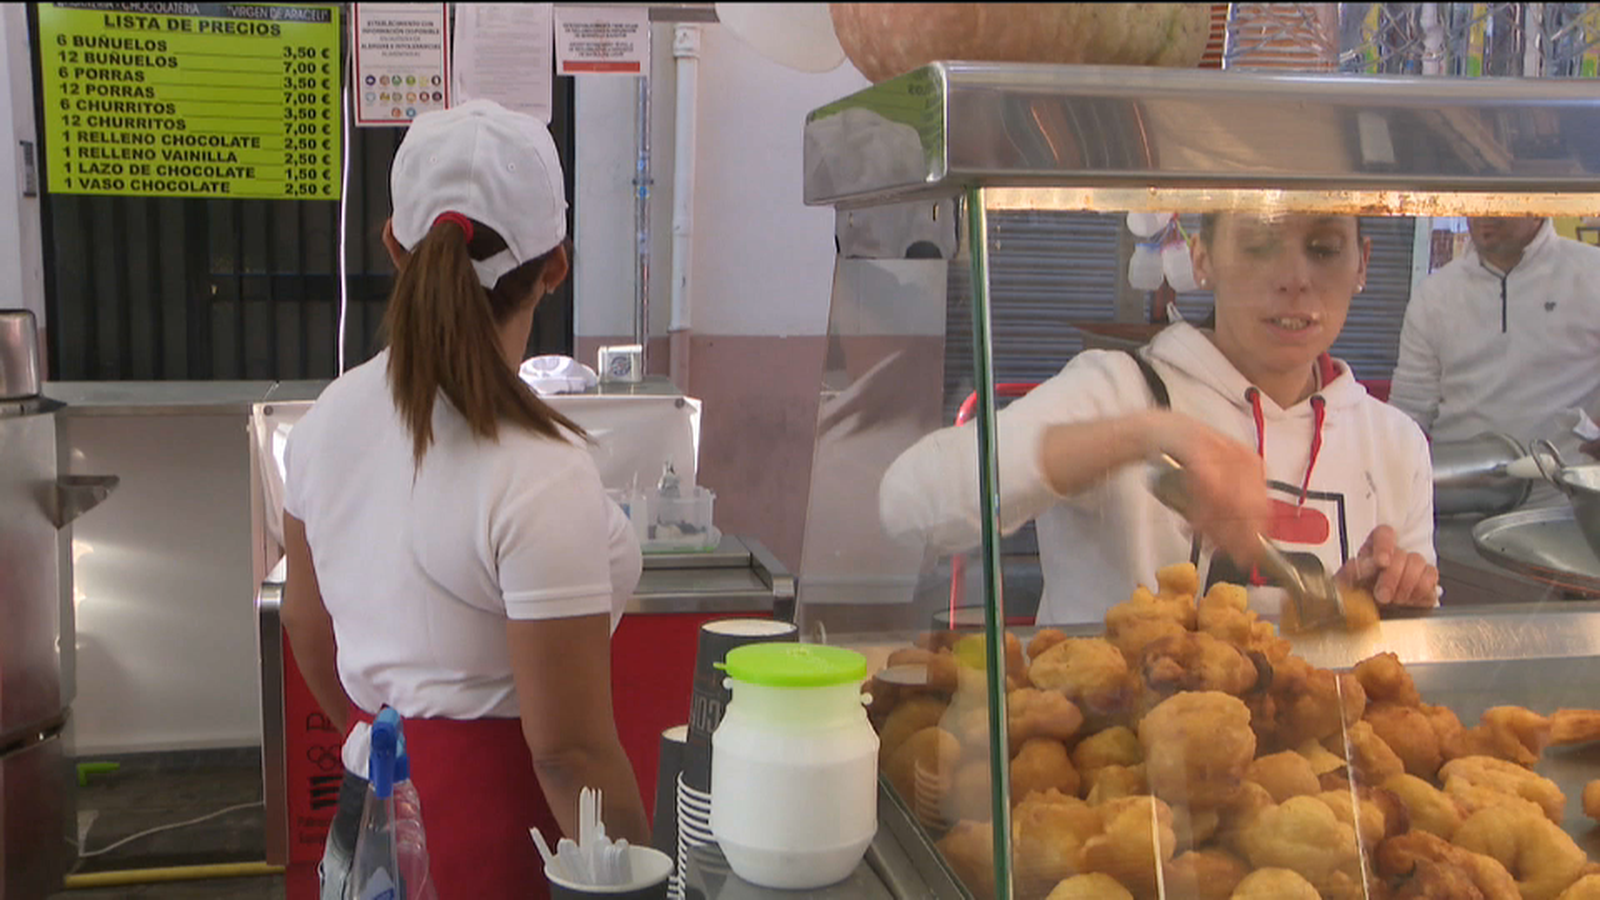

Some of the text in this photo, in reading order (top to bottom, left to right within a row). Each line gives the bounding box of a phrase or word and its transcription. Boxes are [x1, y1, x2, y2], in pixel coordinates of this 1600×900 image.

[270, 7, 283, 19] DE
[104, 14, 281, 36] LISTA DE PRECIOS
[57, 34, 330, 59] 6 BUÑUELOS 3,50 €
[59, 51, 330, 75] 12 BUÑUELOS 7,00 €
[59, 66, 330, 90] 6 PORRAS 3,50 €
[60, 83, 331, 105] 12 PORRAS 7,00 €
[60, 99, 331, 121] 6 CHURRITOS 3,50 €
[62, 115, 331, 136] 12 CHURRITOS 7,00 €
[63, 131, 331, 151] 1 RELLENO CHOCOLATE 2,50 €
[64, 147, 331, 167] 1 RELLENO VAINILLA 2,50 €
[65, 162, 331, 181] 1 LAZO DE CHOCOLATE 1,50 €
[65, 177, 331, 197] 1 VASO CHOCOLATE 2,50 €
